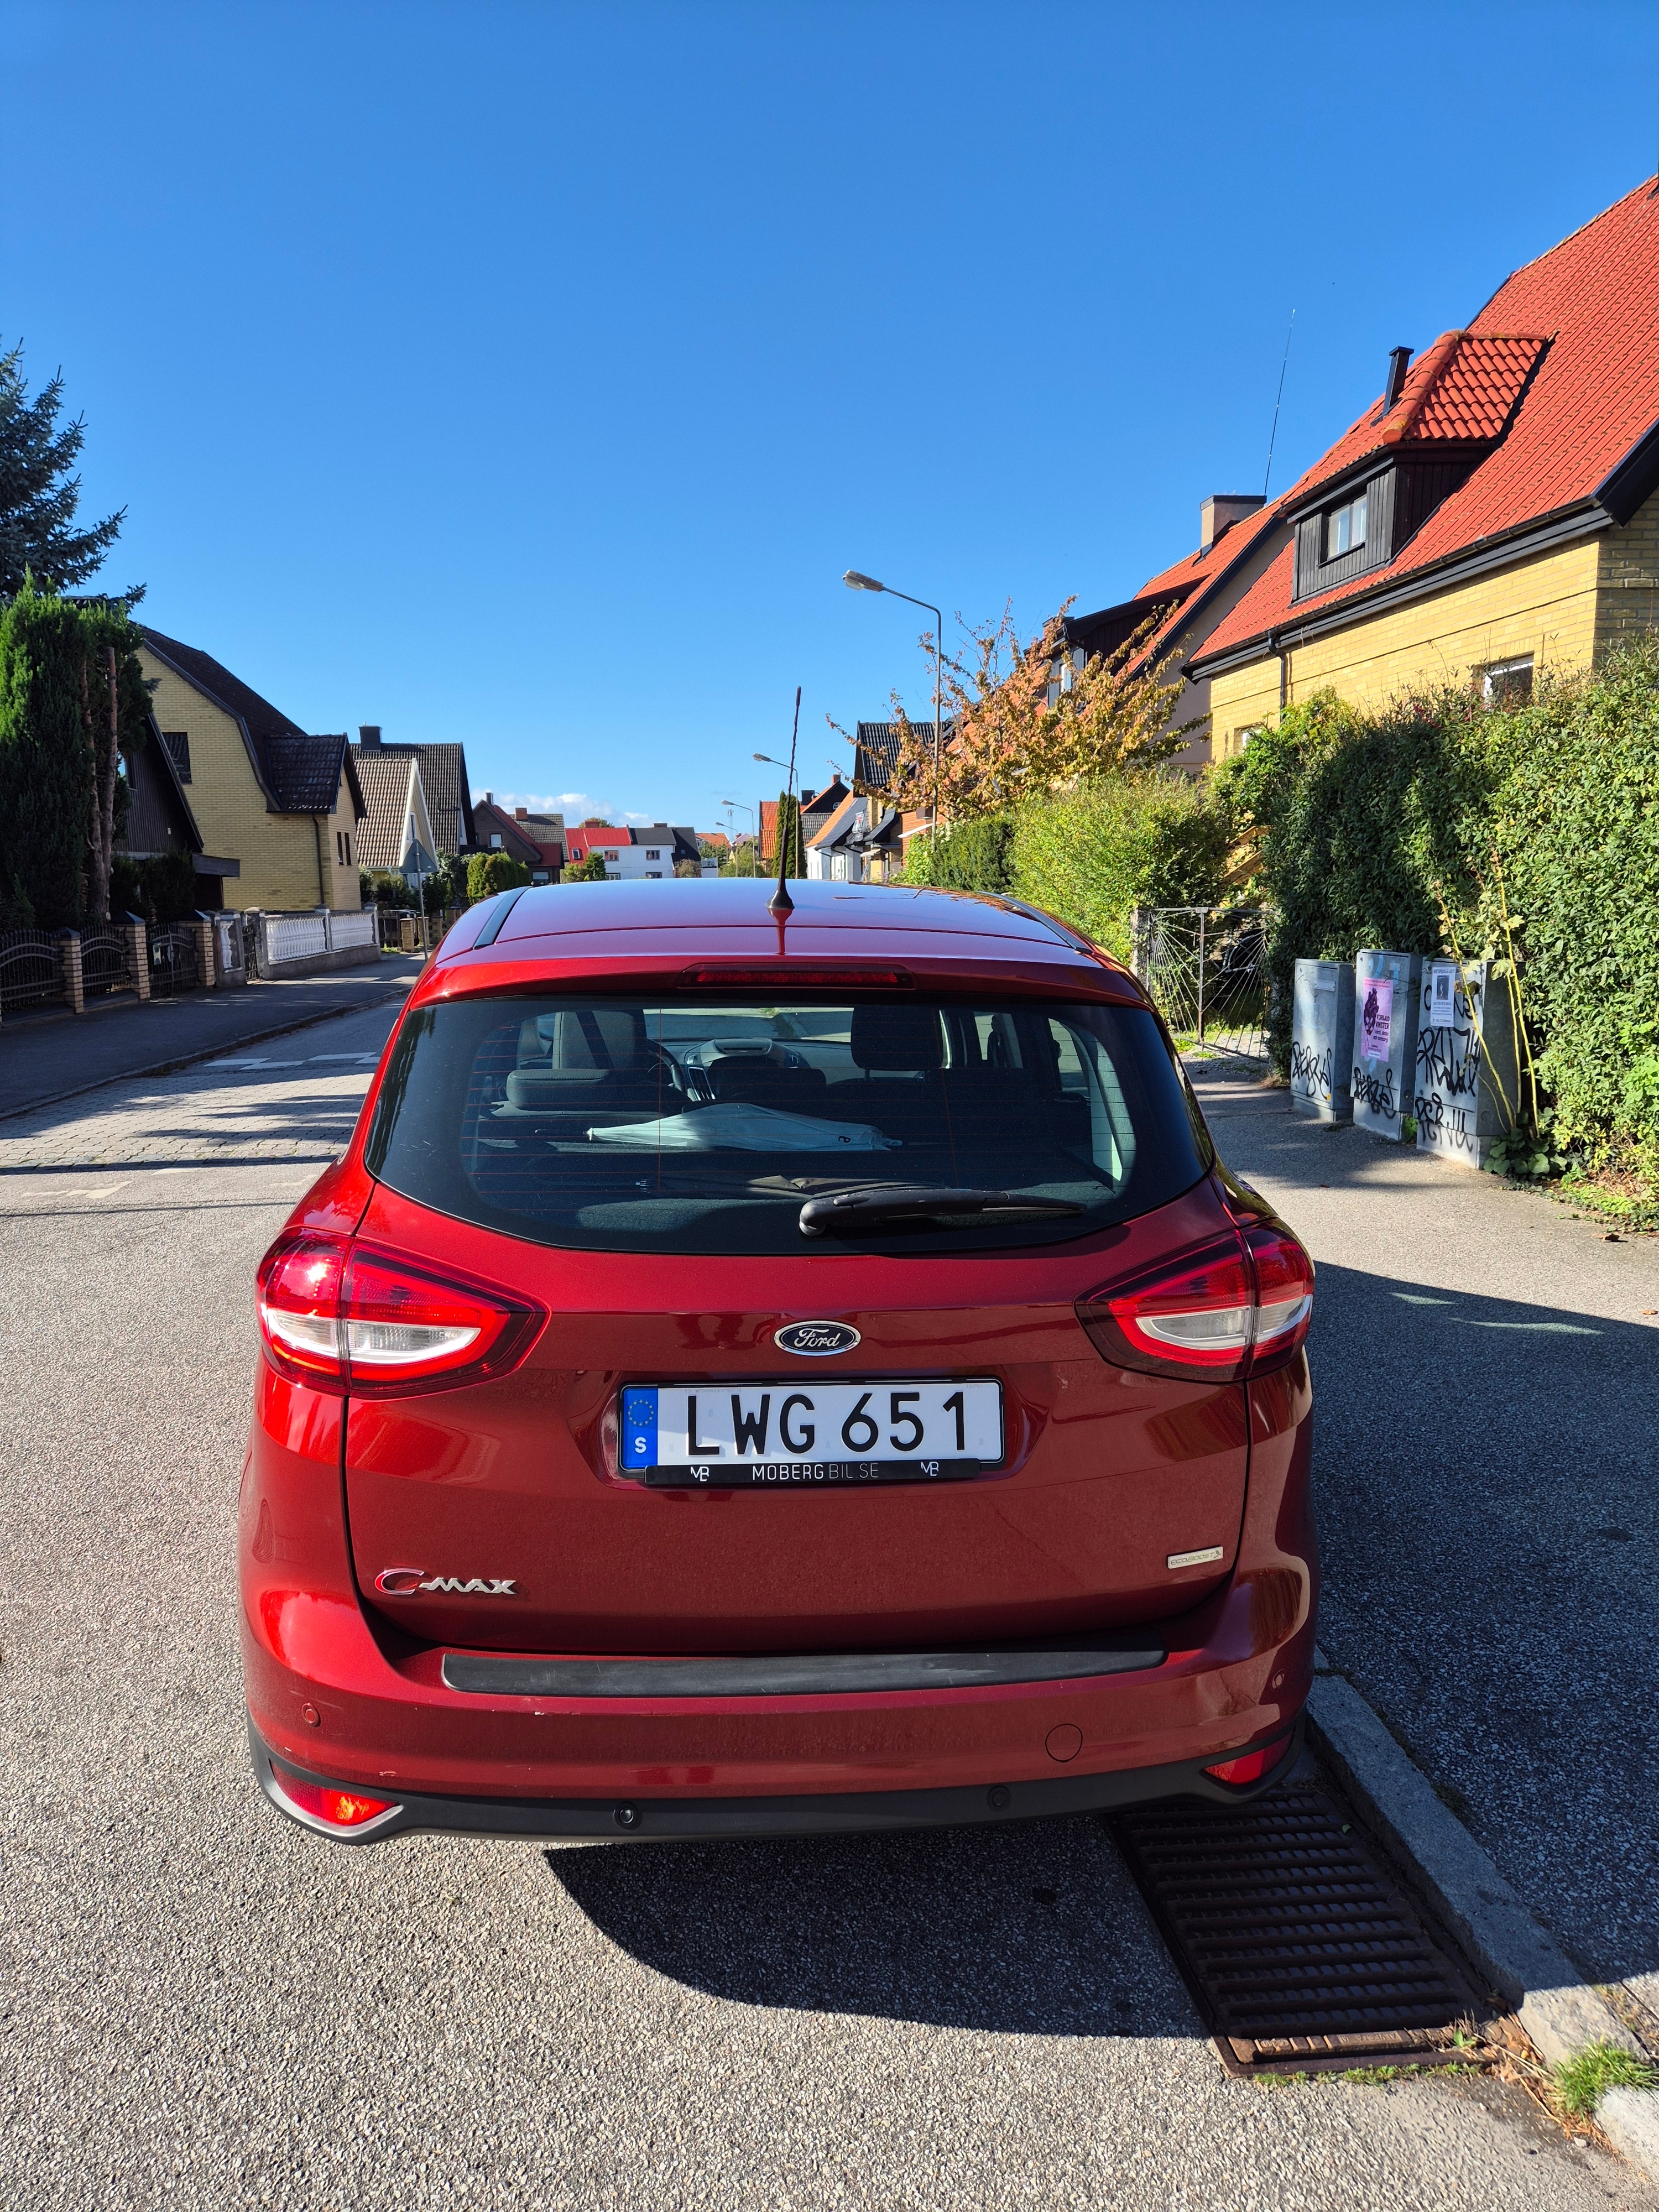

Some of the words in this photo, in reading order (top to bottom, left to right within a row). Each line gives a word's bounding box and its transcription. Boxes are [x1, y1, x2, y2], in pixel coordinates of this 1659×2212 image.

[794, 1328, 841, 1347] Ford
[687, 1394, 815, 1455] LWG
[841, 1392, 965, 1453] 651
[634, 1437, 647, 1454] S
[752, 1464, 824, 1481] MOBERG
